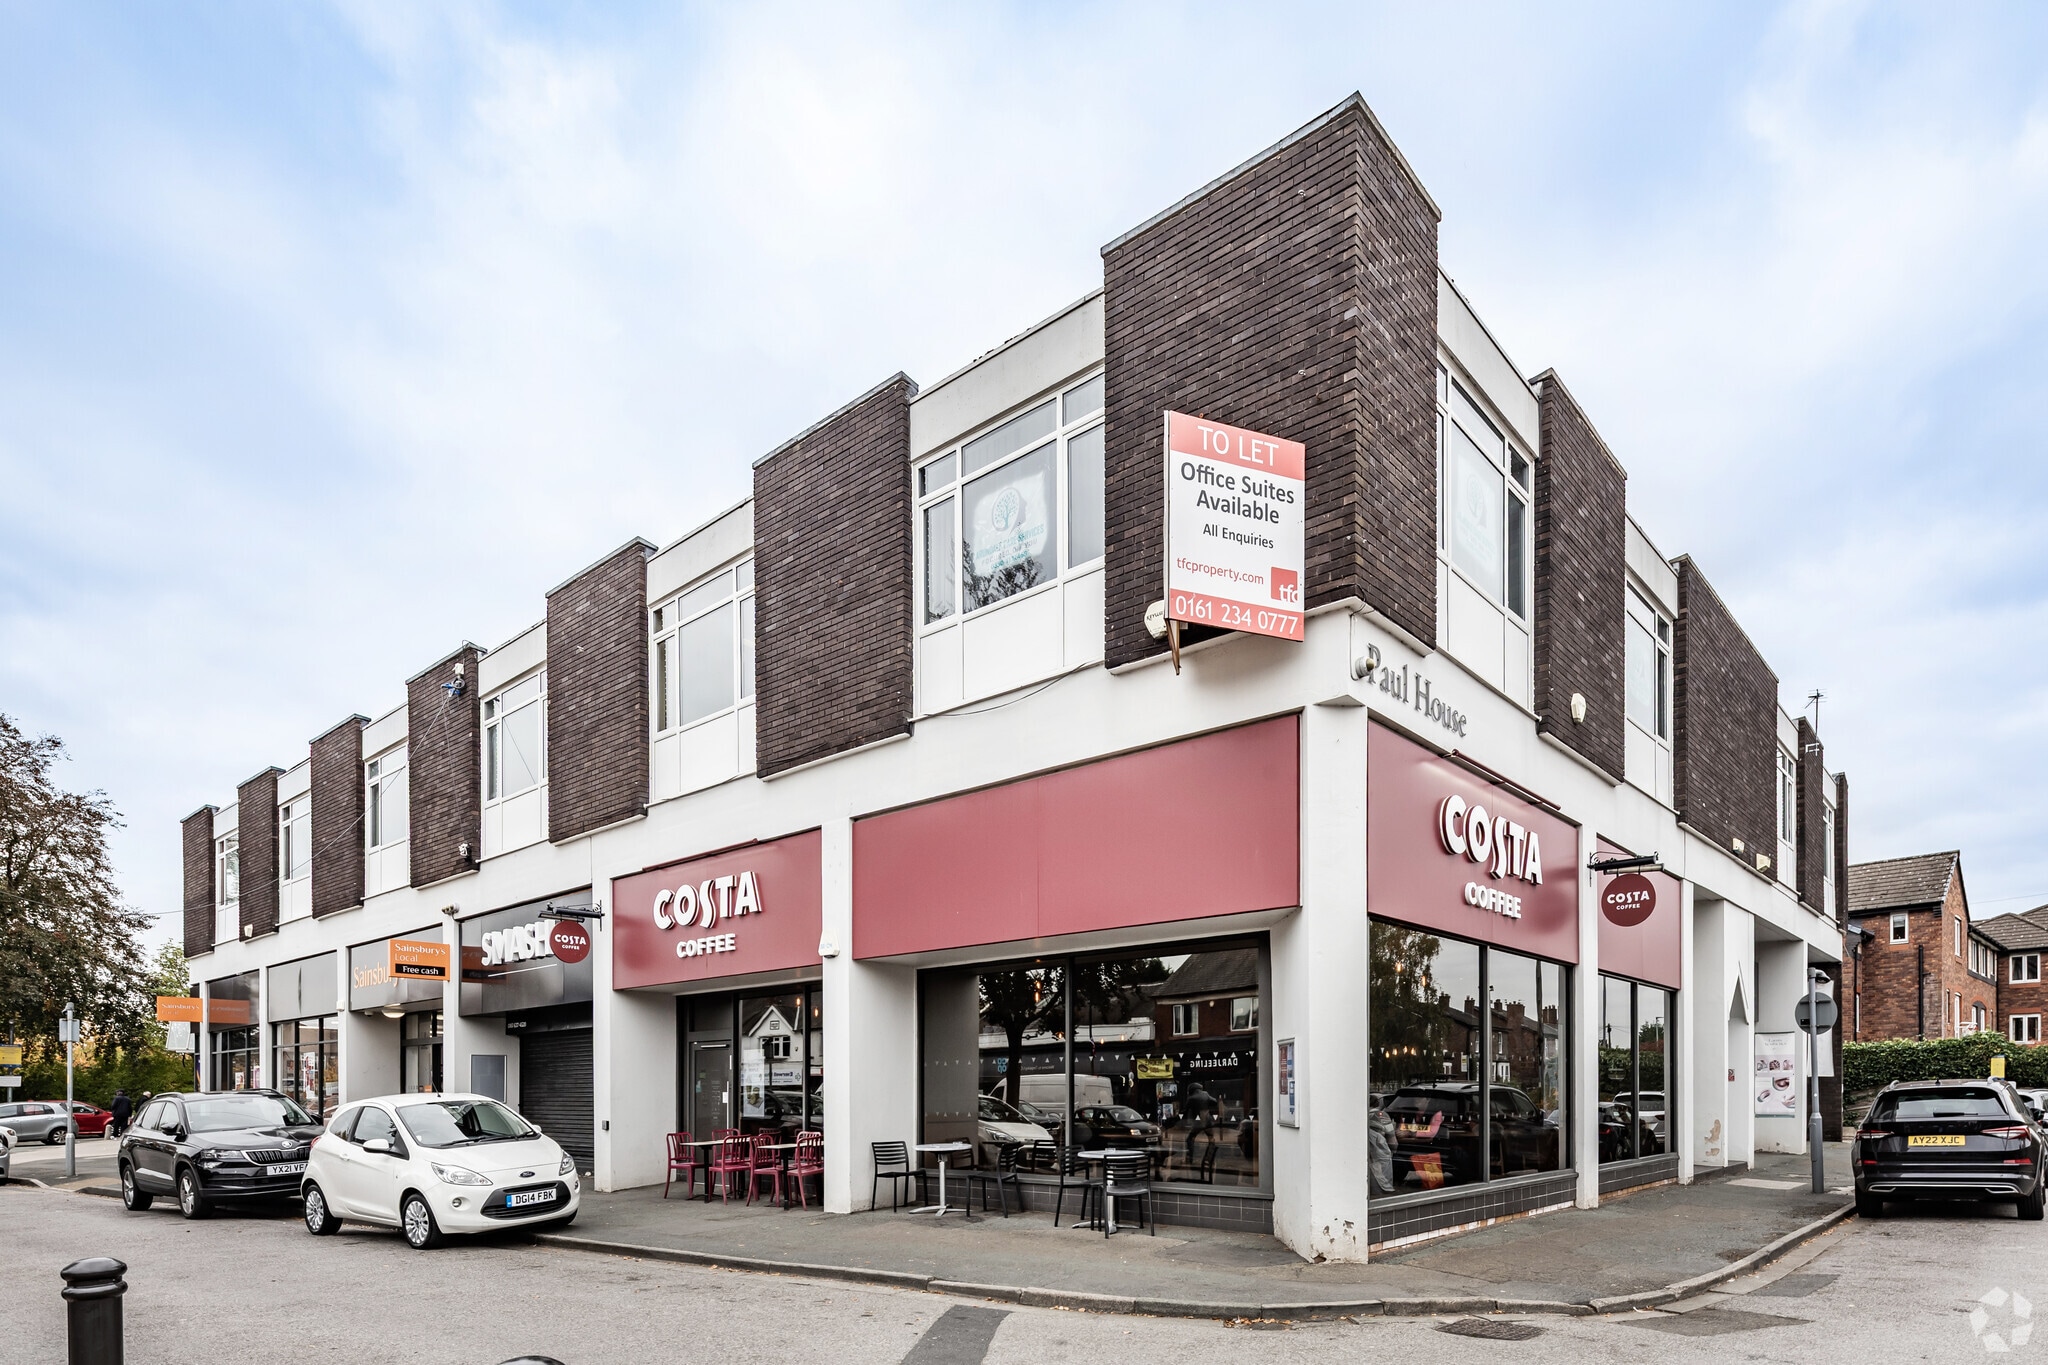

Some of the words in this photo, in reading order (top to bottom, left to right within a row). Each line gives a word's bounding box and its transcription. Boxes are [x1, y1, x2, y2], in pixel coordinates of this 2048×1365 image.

[1197, 425, 1230, 456] TO
[1239, 434, 1279, 467] LET
[1180, 461, 1236, 491] Office
[1241, 475, 1295, 504] Suites
[1196, 489, 1280, 524] Available
[1202, 522, 1219, 538] All
[1222, 527, 1274, 549] Enquiries
[1176, 557, 1264, 585] tfcproperty.com
[1175, 594, 1212, 620] 0161
[1221, 603, 1252, 627] 234
[1257, 610, 1298, 635] 0777
[1367, 642, 1408, 704] Paul
[1414, 672, 1468, 738] House
[1439, 794, 1544, 886] COSTA
[653, 870, 762, 930] COSTA
[1464, 881, 1522, 919] COFFEE
[1606, 890, 1650, 904] COSTA
[394, 943, 446, 956] Sainsbury's
[481, 919, 555, 966] SMASH
[554, 934, 586, 945] COSTA
[676, 932, 737, 959] COFFEE
[394, 953, 418, 962] Local
[402, 965, 420, 974] Free
[420, 967, 439, 975] cash
[1912, 1136, 1938, 1144] AY22
[1941, 1136, 1961, 1144] XJC
[272, 1165, 292, 1173] YX21
[515, 1193, 535, 1204] DG14
[537, 1190, 554, 1201] FBK
